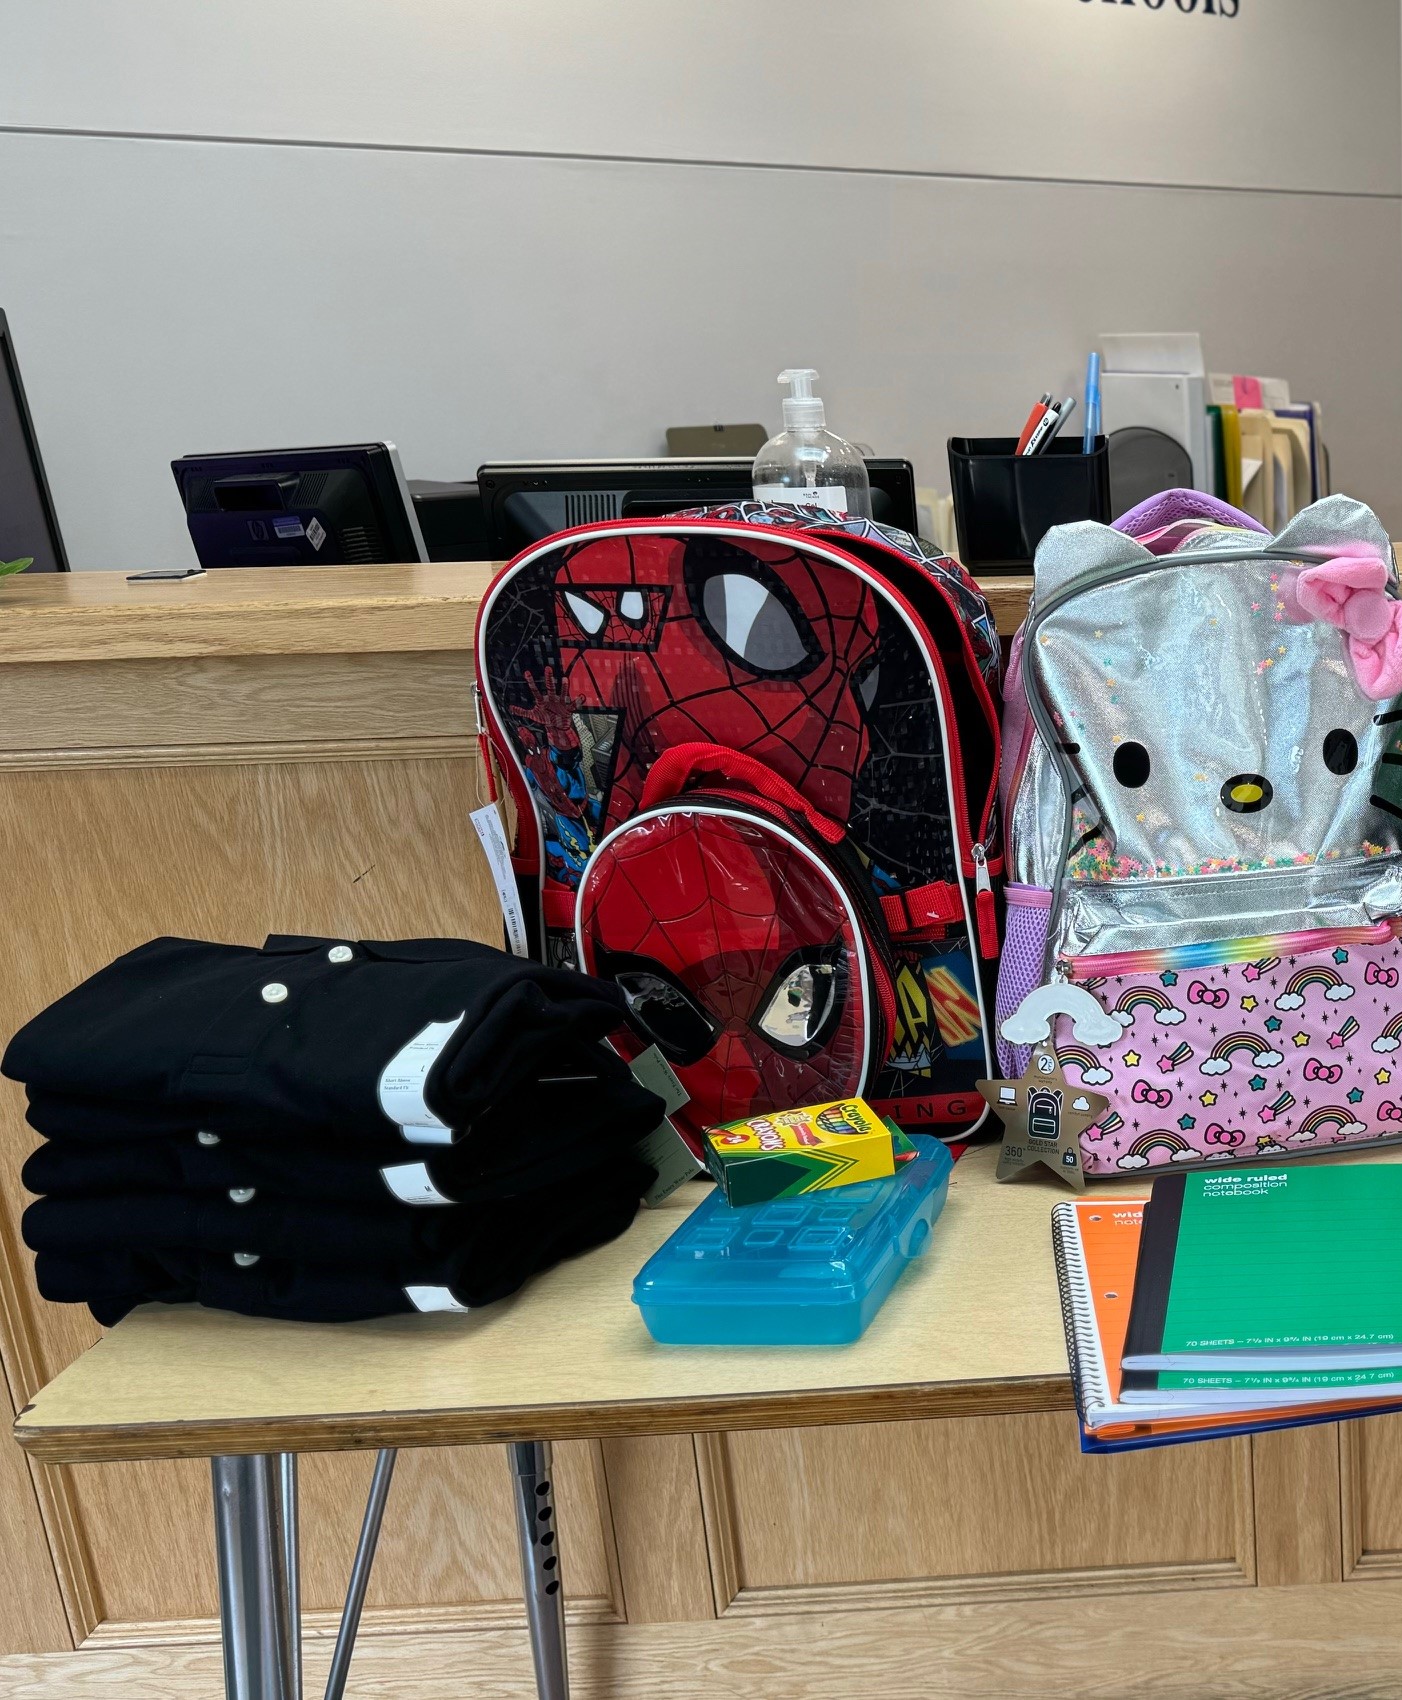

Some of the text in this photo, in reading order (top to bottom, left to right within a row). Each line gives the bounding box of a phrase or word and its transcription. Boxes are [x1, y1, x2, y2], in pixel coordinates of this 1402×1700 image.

[839, 1103, 873, 1134] Crayola
[747, 1118, 787, 1151] CRAYONS
[1027, 1143, 1060, 1155] COLLECTION
[1065, 1155, 1075, 1163] 50
[1204, 1172, 1288, 1184] wide ruled
[1202, 1180, 1288, 1192] composition
[1202, 1187, 1270, 1198] notebook
[1185, 1339, 1199, 1348] 70
[1199, 1338, 1235, 1347] SHEETS
[1263, 1336, 1274, 1345] IN
[1301, 1335, 1312, 1343] IN
[1313, 1334, 1329, 1342] (19
[1354, 1333, 1376, 1341] 24.7
[1376, 1333, 1394, 1341] cm)
[1182, 1377, 1196, 1385] 70
[1196, 1376, 1233, 1385] SHEETS
[1261, 1376, 1273, 1384] IN
[1301, 1375, 1312, 1384] IN
[1313, 1374, 1329, 1384] (19
[1377, 1371, 1395, 1380] cm)
